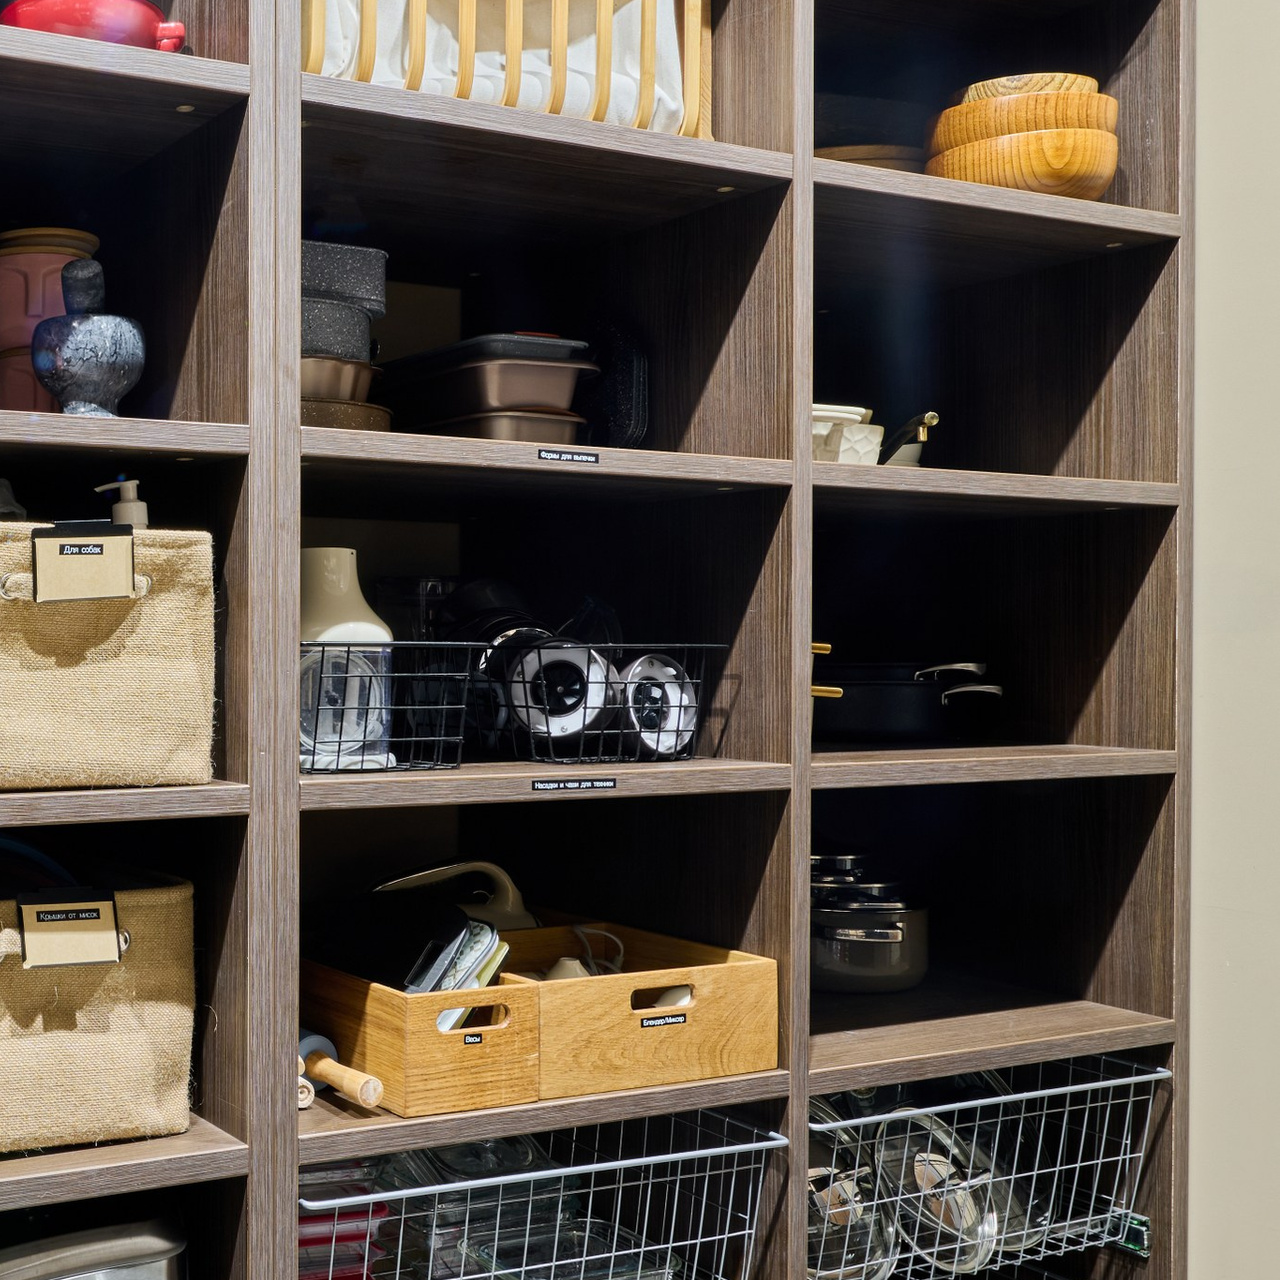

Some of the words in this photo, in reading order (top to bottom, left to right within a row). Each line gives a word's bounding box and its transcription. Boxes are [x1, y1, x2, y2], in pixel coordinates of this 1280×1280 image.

[540, 450, 560, 460] Формы
[63, 545, 79, 555] Для
[81, 545, 101, 554] собак
[534, 781, 558, 790] Насадки
[40, 912, 66, 921] Крышки
